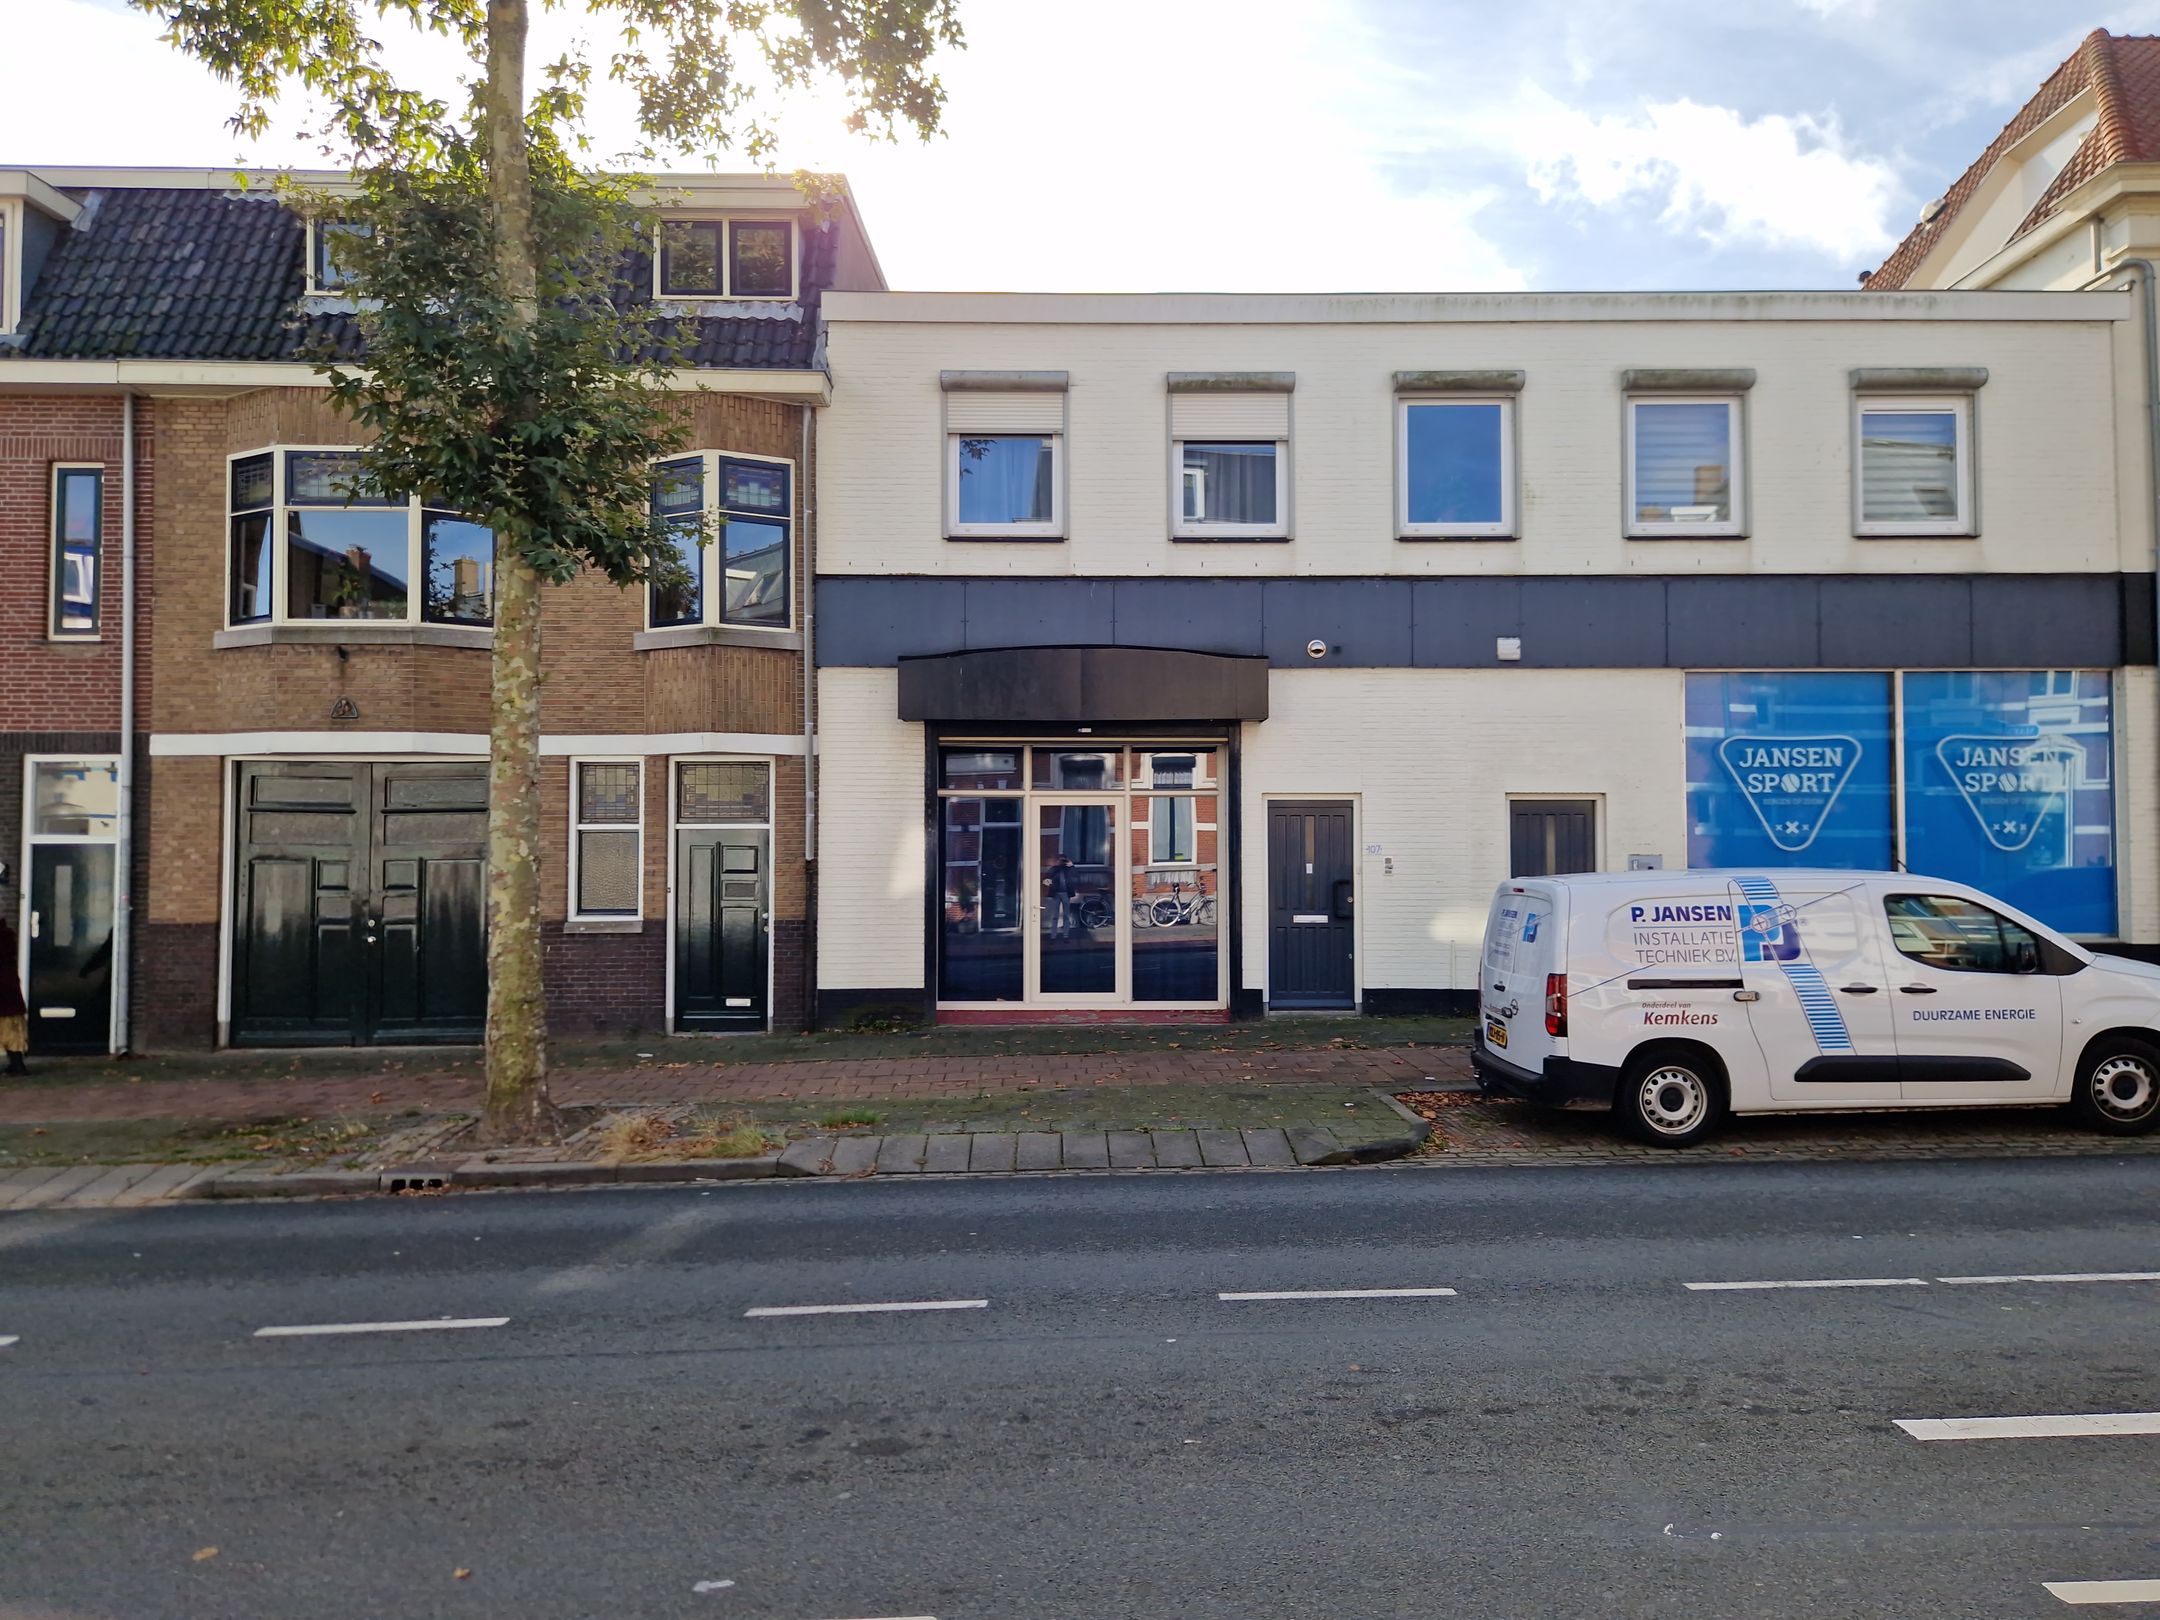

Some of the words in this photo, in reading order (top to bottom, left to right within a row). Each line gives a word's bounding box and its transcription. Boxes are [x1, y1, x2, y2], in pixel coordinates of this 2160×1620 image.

[1739, 747, 1843, 768] JANSEN
[1956, 746, 2060, 767] JANSEN
[1747, 773, 1836, 793] SPORT
[1631, 906, 1645, 922] P.
[1651, 905, 1732, 922] JANSEN
[1634, 931, 1734, 946] INSTALLATIE
[1636, 949, 1711, 964] TECHNIEK
[1643, 1010, 1719, 1025] Kemkens
[1913, 1010, 1981, 1021] DUURZAME
[1984, 1009, 2036, 1020] ENERGIE
